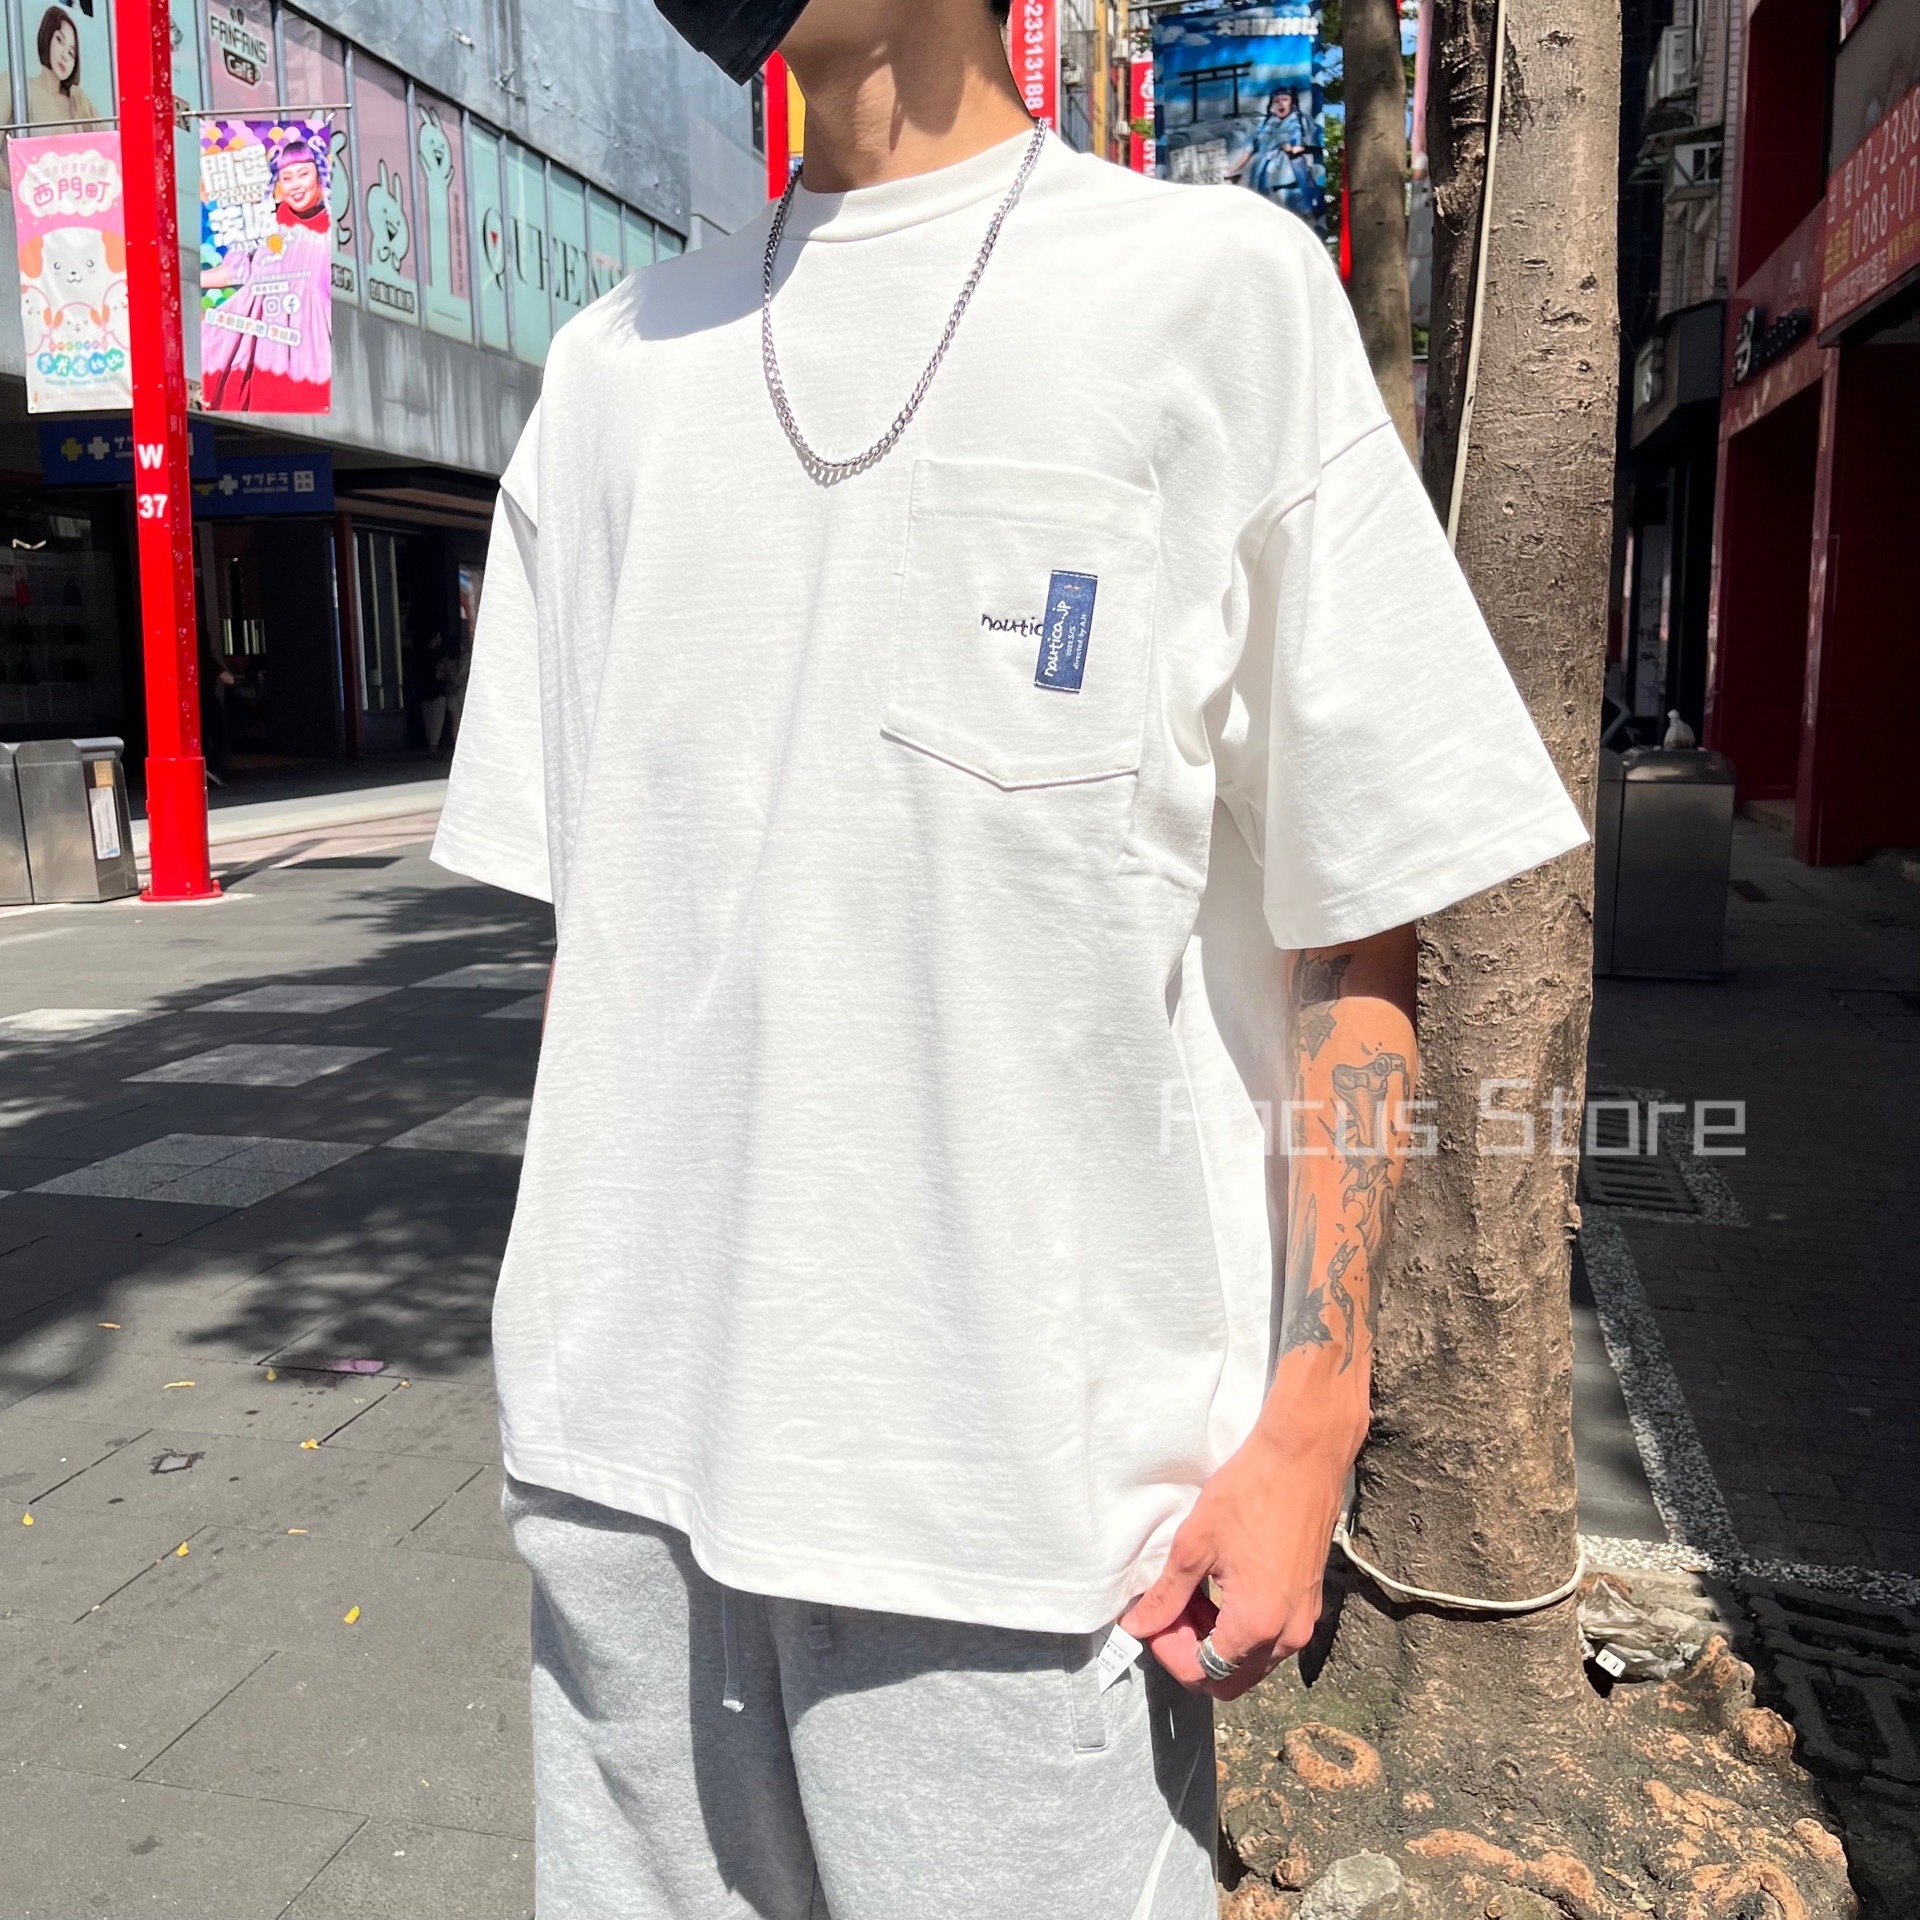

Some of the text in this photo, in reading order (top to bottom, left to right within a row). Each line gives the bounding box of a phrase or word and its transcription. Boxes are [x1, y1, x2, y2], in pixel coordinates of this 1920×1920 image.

[33, 176, 111, 207] 西門町
[137, 443, 164, 469] W
[139, 494, 168, 518] 37
[1044, 600, 1072, 677] nautica.jp
[1065, 625, 1076, 656] 2022 S/S
[1073, 640, 1083, 670] directed
[1078, 628, 1087, 637] by
